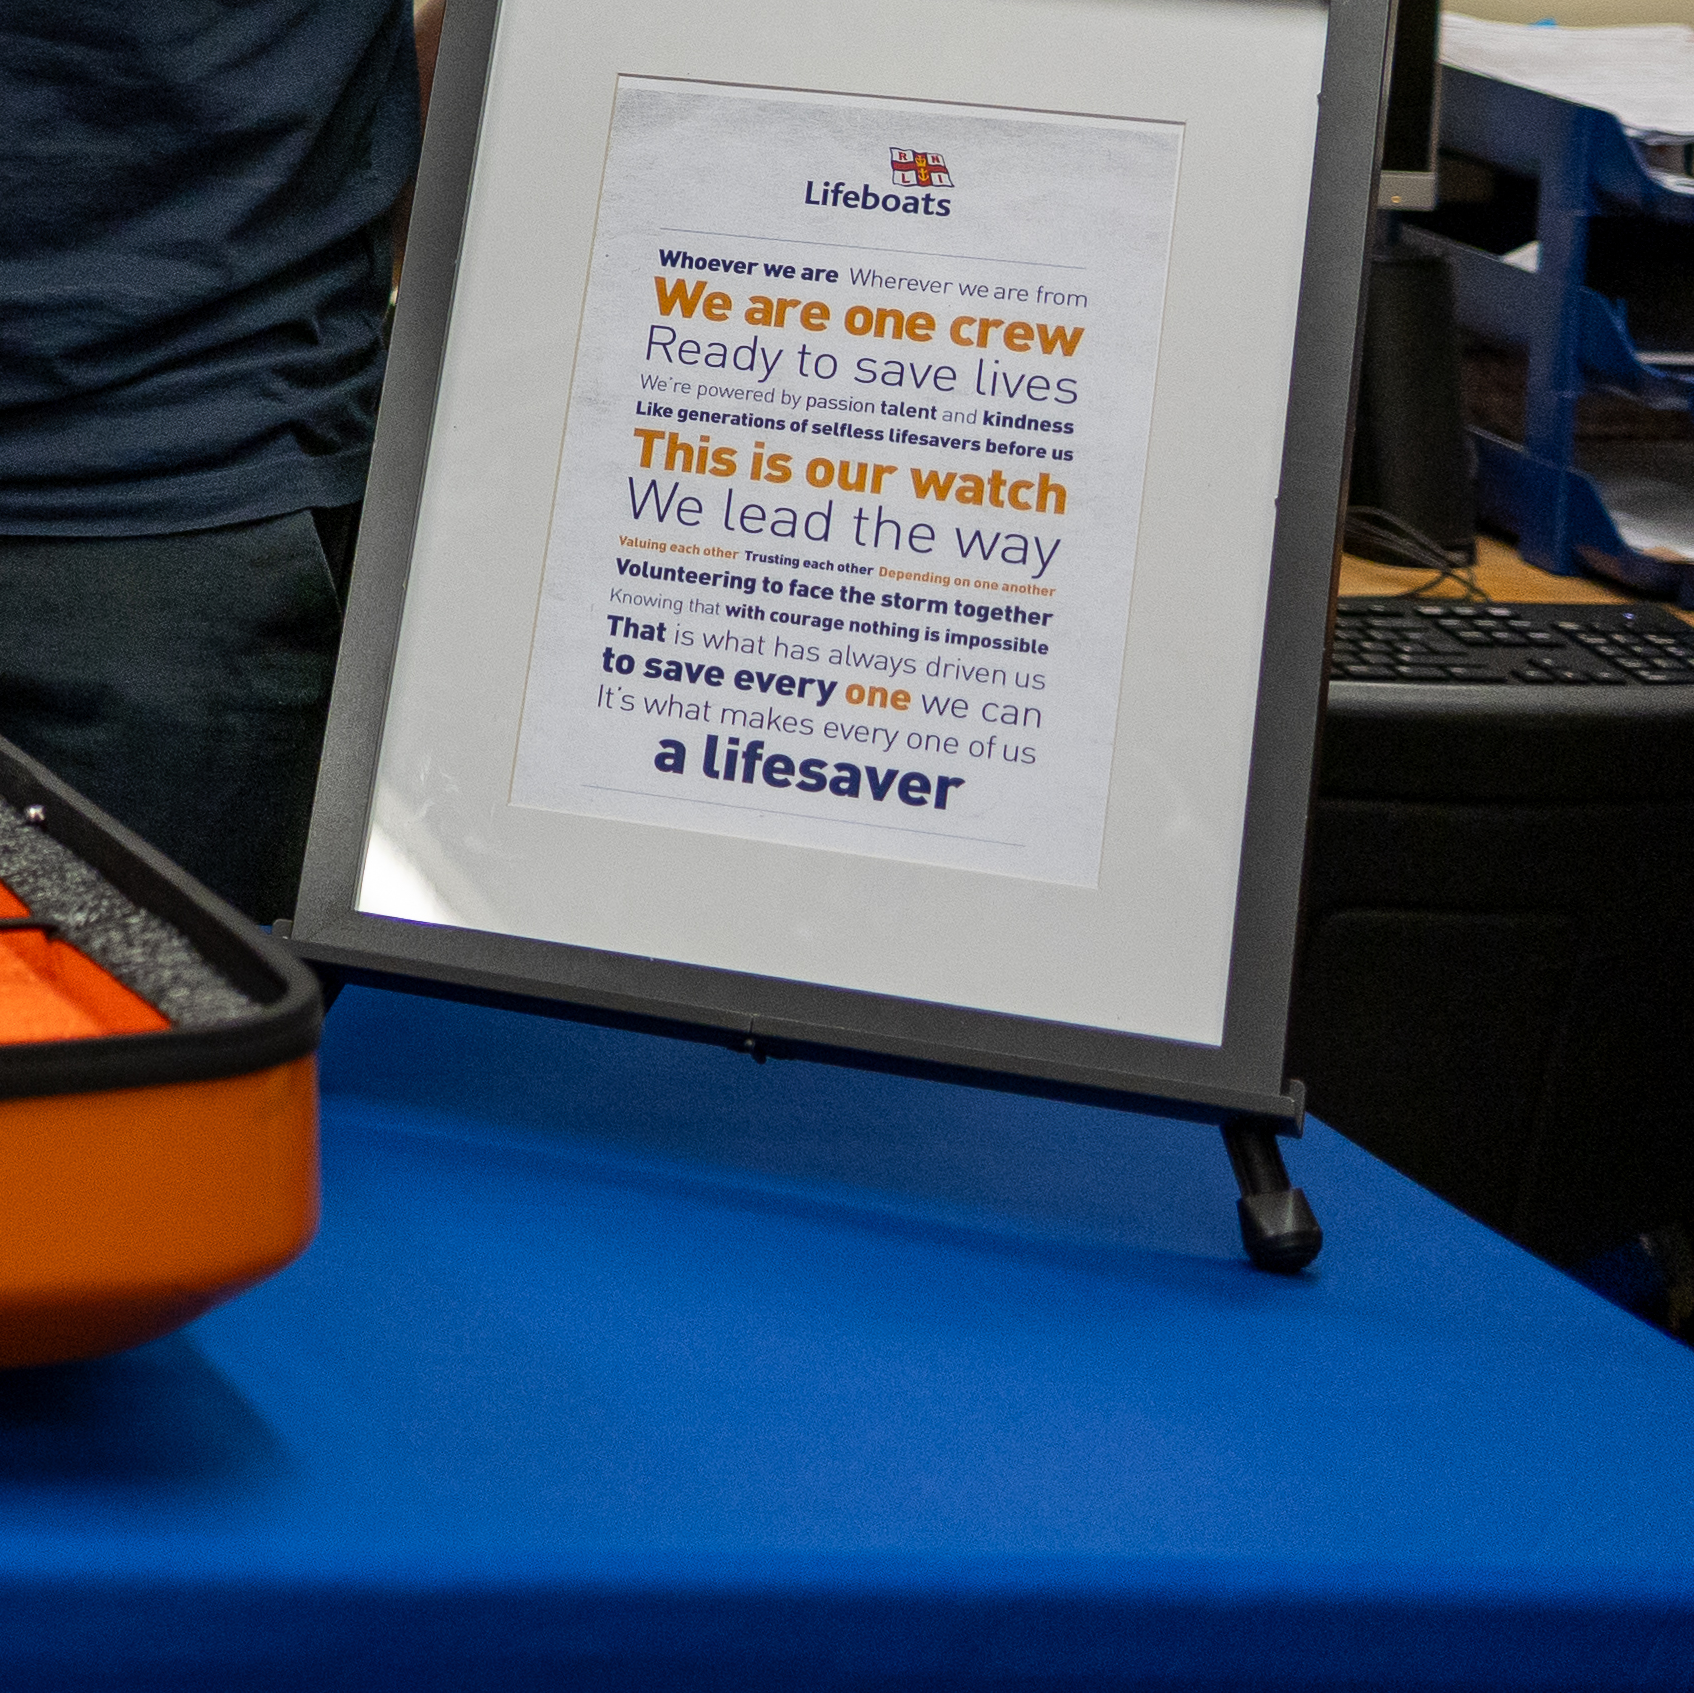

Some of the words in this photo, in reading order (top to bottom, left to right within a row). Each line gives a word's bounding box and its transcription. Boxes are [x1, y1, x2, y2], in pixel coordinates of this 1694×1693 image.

[804, 180, 951, 217] Lifeboats
[659, 249, 759, 275] Whoever
[763, 263, 796, 279] we
[801, 267, 839, 283] are
[850, 268, 953, 293] Wherever
[959, 284, 989, 298] we
[994, 287, 1028, 301] are
[1037, 286, 1087, 307] from
[654, 276, 733, 322] We
[744, 295, 831, 332] are
[844, 305, 937, 343] one
[950, 315, 1085, 357] crew
[646, 325, 783, 383] Ready
[798, 344, 838, 379] to
[854, 358, 957, 392] save
[976, 358, 1078, 404] lives
[636, 400, 673, 418] Like
[677, 408, 786, 431] generations
[790, 419, 809, 433] of
[811, 422, 884, 441] selfless
[889, 428, 981, 452] lifesavers
[985, 438, 1047, 459] before
[1052, 448, 1073, 462] us
[641, 374, 691, 394] We're
[697, 385, 775, 403] powered
[781, 390, 801, 409] by
[806, 396, 875, 413] passion
[881, 400, 937, 420] talent
[943, 410, 977, 424] and
[983, 410, 1074, 435] kindness
[634, 428, 738, 478] This
[750, 441, 793, 484] is
[806, 457, 898, 495] our
[910, 468, 1067, 515] watch
[619, 536, 667, 553] Valuing
[670, 544, 700, 555] each
[703, 547, 739, 559] other
[745, 550, 800, 569] Trusting
[803, 560, 834, 571] each
[837, 563, 874, 575] other
[879, 566, 950, 587] Depending
[954, 576, 971, 588] on
[974, 580, 999, 590] one
[1002, 584, 1055, 596] another
[628, 477, 703, 526] We
[724, 488, 833, 542] lead
[854, 505, 935, 554] the
[955, 527, 1061, 579] way
[610, 589, 683, 614] Knowing
[690, 599, 720, 615] that
[725, 604, 765, 621] with
[770, 611, 844, 632] courage
[849, 620, 920, 643] nothing
[924, 626, 940, 642] is
[945, 628, 1049, 655] impossible
[616, 557, 757, 595] Volunteering
[762, 576, 783, 594] to
[789, 579, 834, 600] face
[840, 586, 876, 605] the
[881, 592, 948, 615] storm
[954, 599, 1054, 626] together
[602, 647, 635, 675] to
[643, 657, 725, 687] save
[734, 669, 838, 707] every
[845, 683, 911, 711] one
[922, 694, 968, 718] we
[982, 702, 1041, 728] can
[607, 614, 667, 643] That
[675, 624, 694, 646] is
[703, 630, 765, 655] what
[775, 636, 819, 662] has
[829, 645, 916, 677] always
[926, 656, 1006, 685] driven
[1015, 672, 1045, 690] us
[598, 684, 634, 711] It's
[644, 694, 711, 722] what
[721, 707, 814, 735] makes
[824, 722, 899, 752] every
[907, 732, 959, 754] one
[969, 735, 996, 758] of
[1003, 744, 1036, 764] us
[654, 738, 686, 775] a
[702, 734, 965, 810] lifesaver
